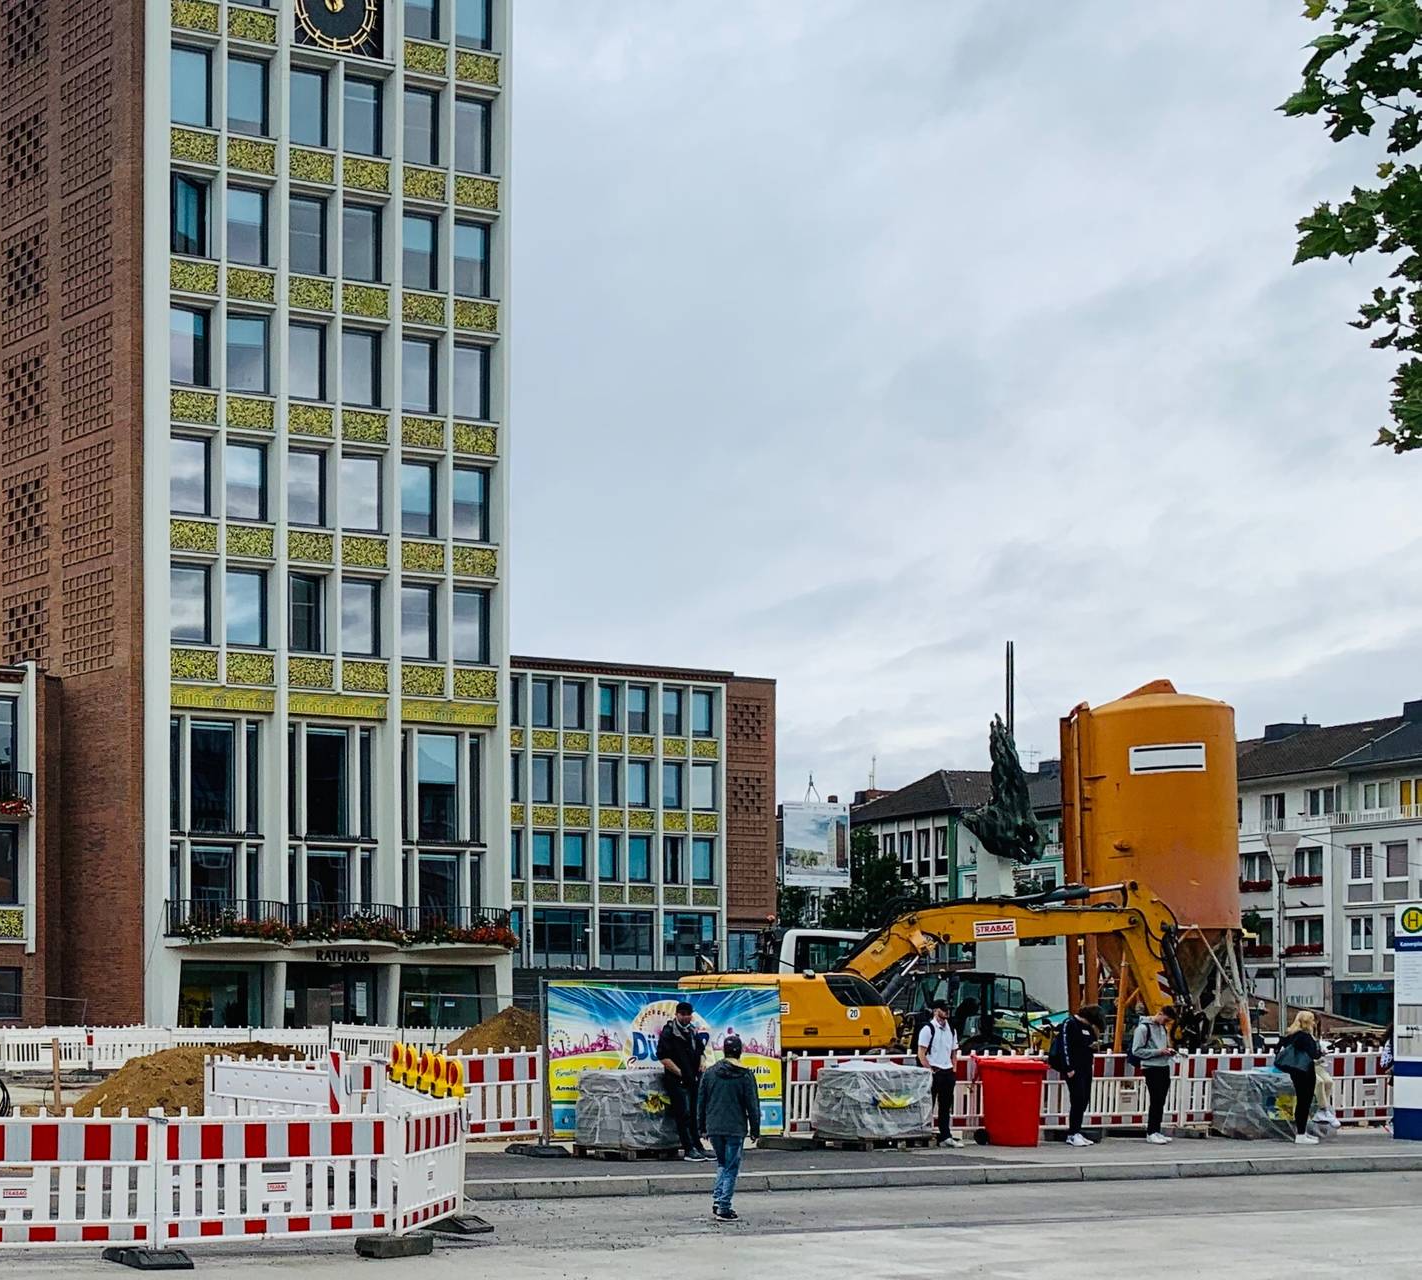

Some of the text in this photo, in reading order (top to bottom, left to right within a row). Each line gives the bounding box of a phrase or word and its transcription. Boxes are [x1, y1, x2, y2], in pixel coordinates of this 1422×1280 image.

[975, 924, 1014, 933] STRABAG
[316, 950, 370, 962] RATHAUS
[850, 1009, 858, 1018] 20
[1002, 1032, 1016, 1041] CAT
